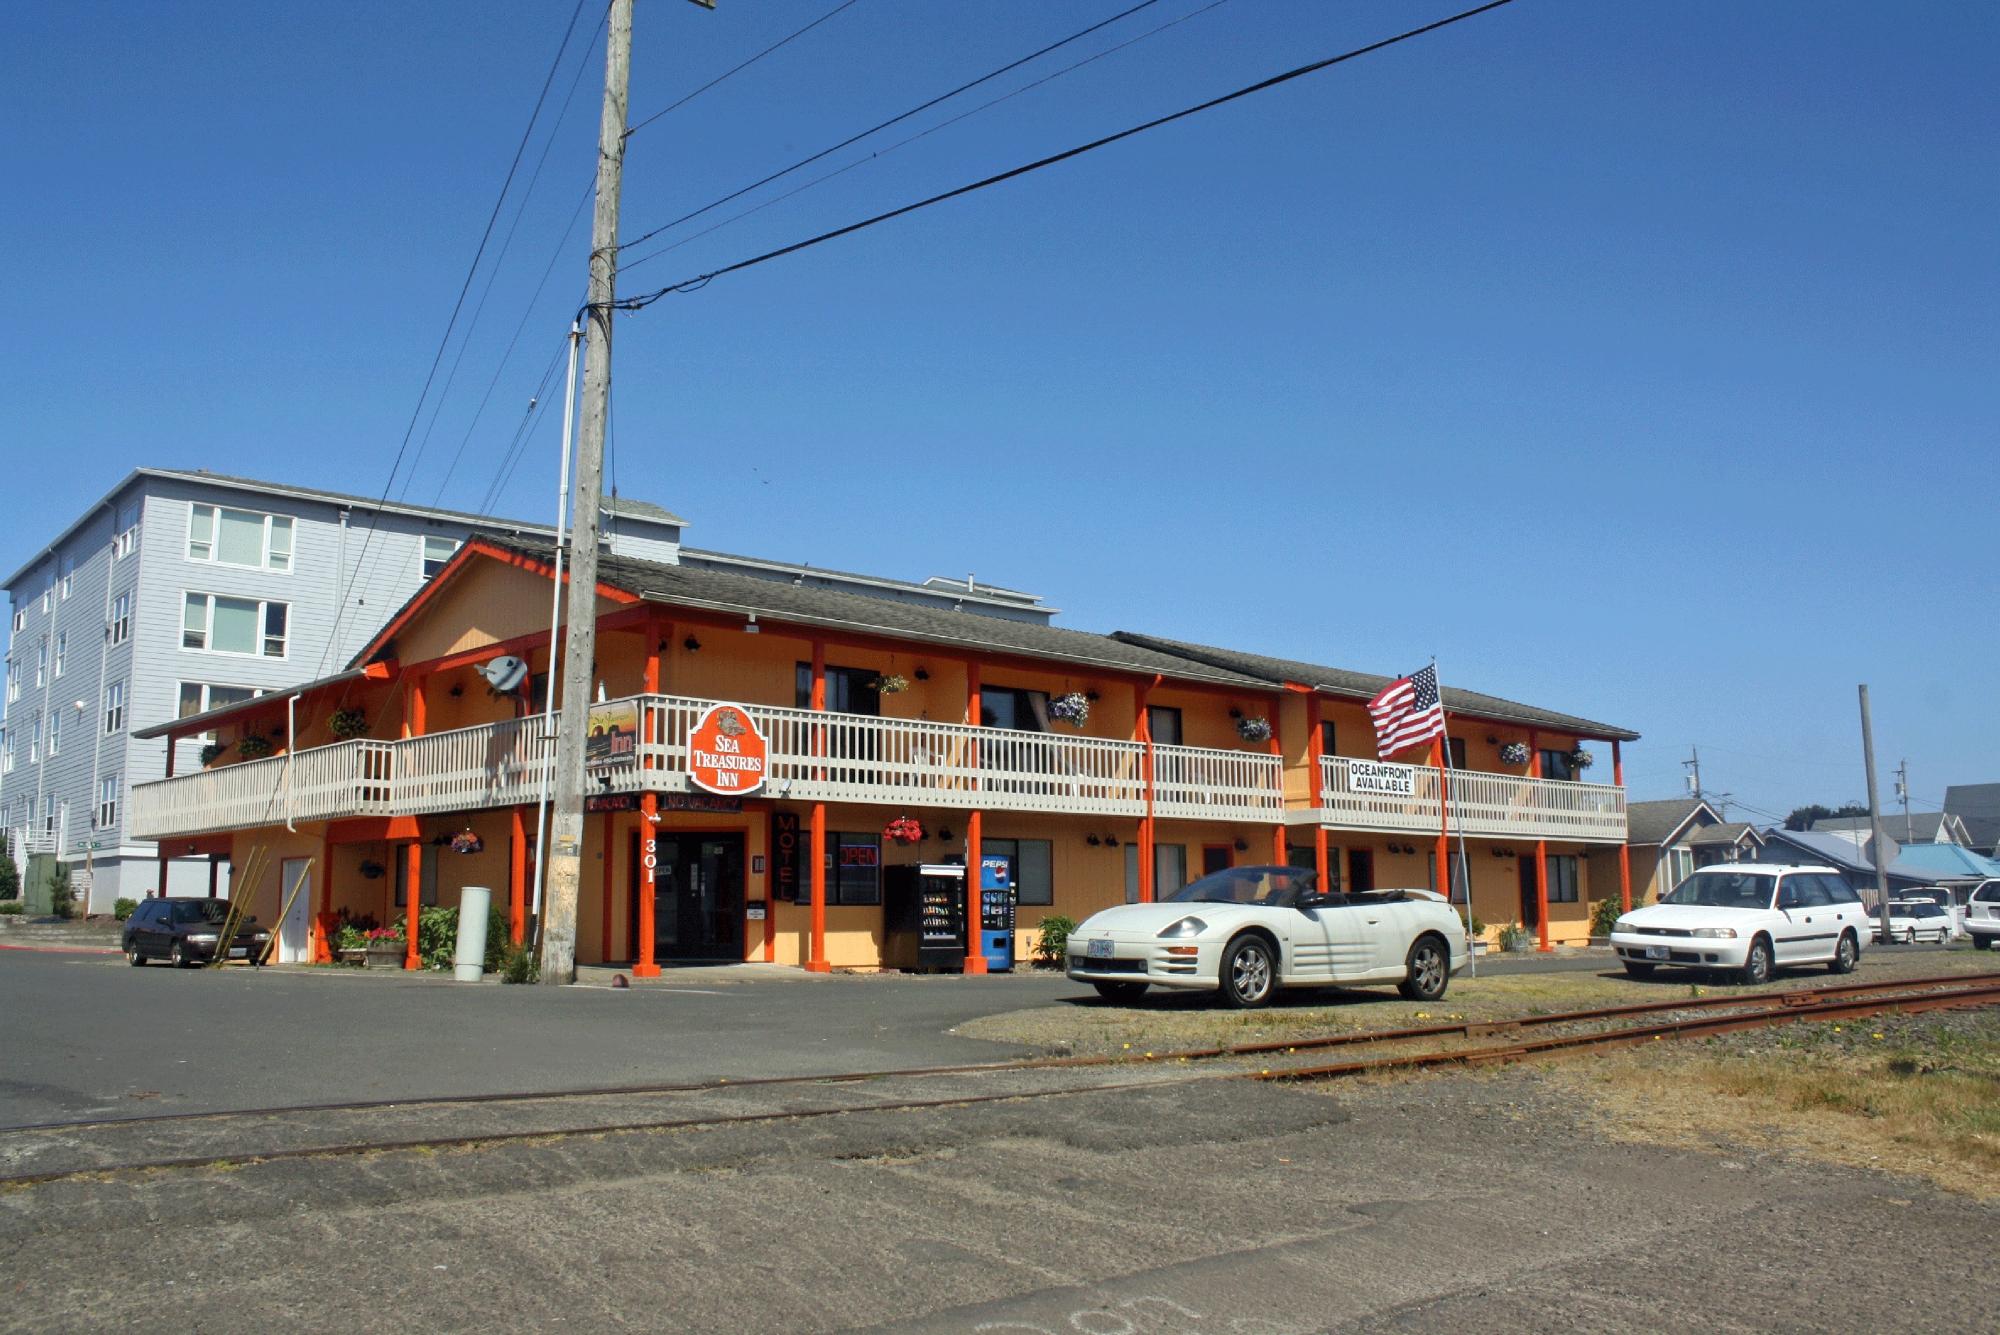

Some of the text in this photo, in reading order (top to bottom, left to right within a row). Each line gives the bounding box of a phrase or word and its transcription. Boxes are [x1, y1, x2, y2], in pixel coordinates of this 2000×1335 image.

[715, 735, 740, 753] SEA
[694, 750, 761, 771] TREASURES
[716, 769, 739, 787] INN
[1351, 763, 1412, 780] OCEANFRONT
[1356, 777, 1410, 792] AVAILABLE
[668, 795, 738, 809] NO VACANCY
[645, 839, 657, 883] 301
[779, 816, 794, 900] MOTEL
[839, 847, 878, 866] OPEN
[982, 860, 1008, 868] PEPSI
